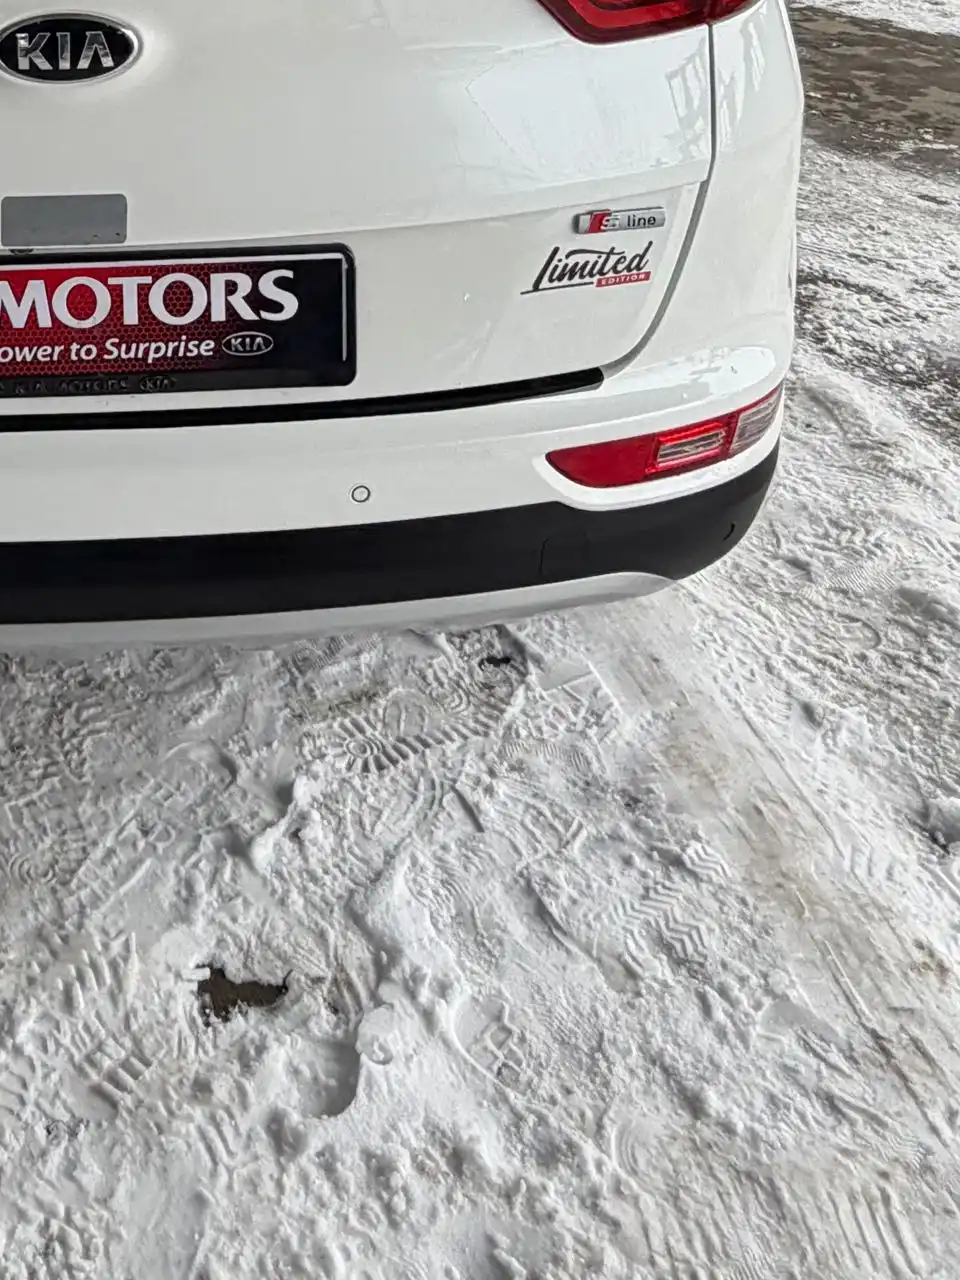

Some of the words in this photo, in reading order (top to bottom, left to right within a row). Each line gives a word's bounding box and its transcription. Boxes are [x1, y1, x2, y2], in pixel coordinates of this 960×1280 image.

[15, 30, 115, 71] KIA
[627, 214, 656, 228] line
[528, 240, 653, 292] Limited
[600, 272, 647, 286] EDITION
[70, 342, 97, 361] to
[103, 335, 216, 363] Surprise
[229, 336, 267, 352] KIA
